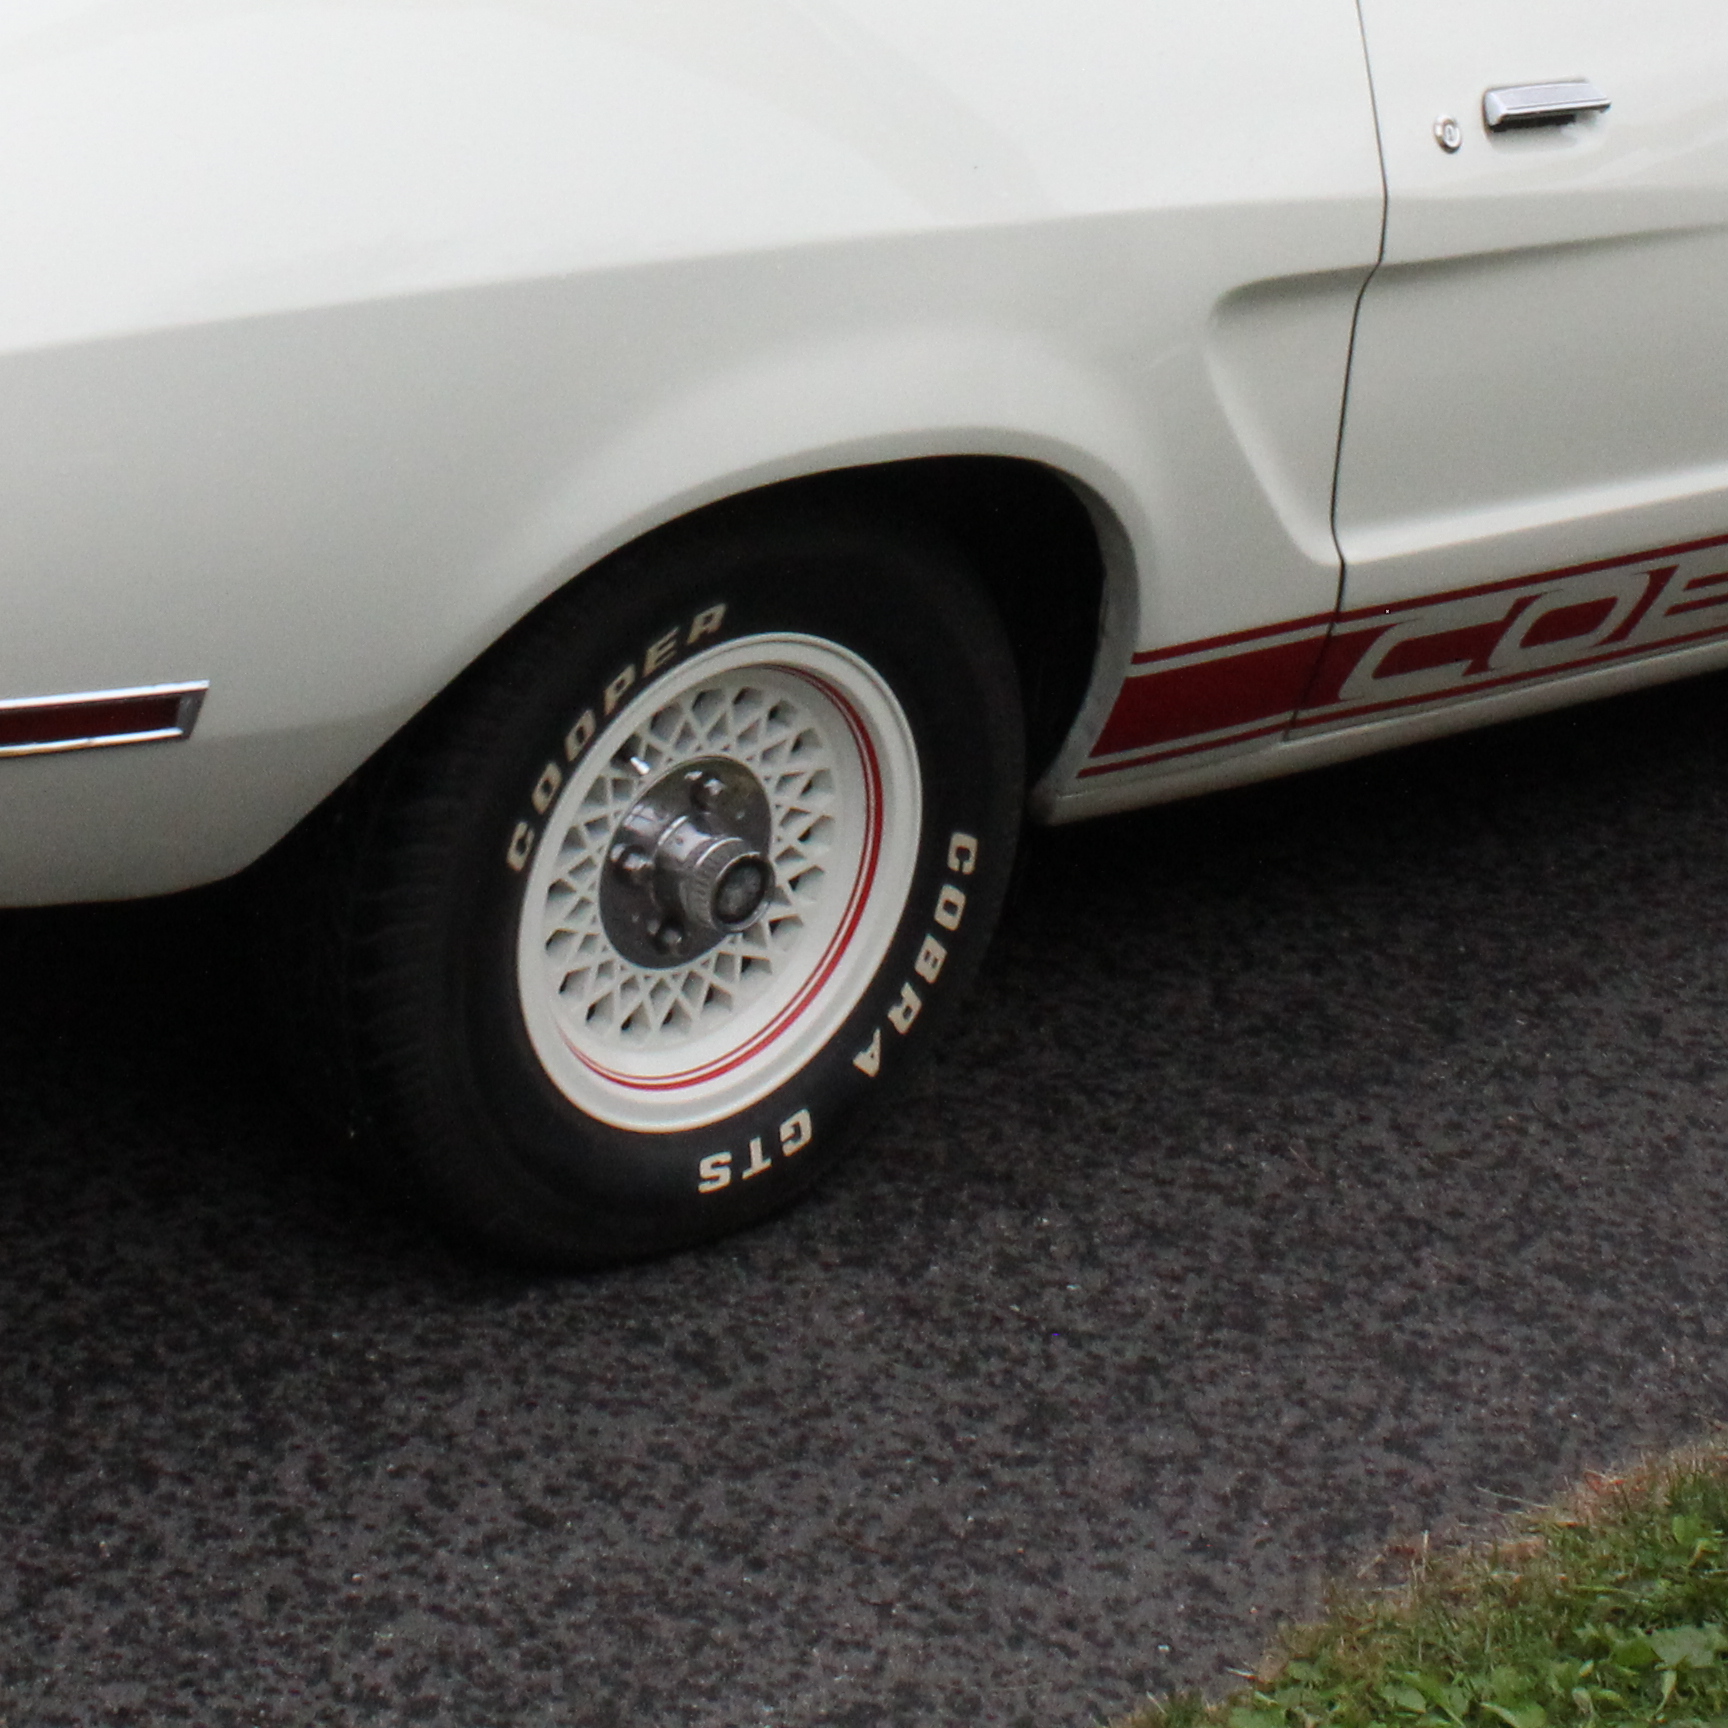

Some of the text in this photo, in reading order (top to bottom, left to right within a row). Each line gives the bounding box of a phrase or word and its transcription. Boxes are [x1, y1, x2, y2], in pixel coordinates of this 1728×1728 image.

[505, 603, 729, 872] COOPER
[852, 832, 978, 1076] COBRA
[697, 1108, 813, 1194] GTS
